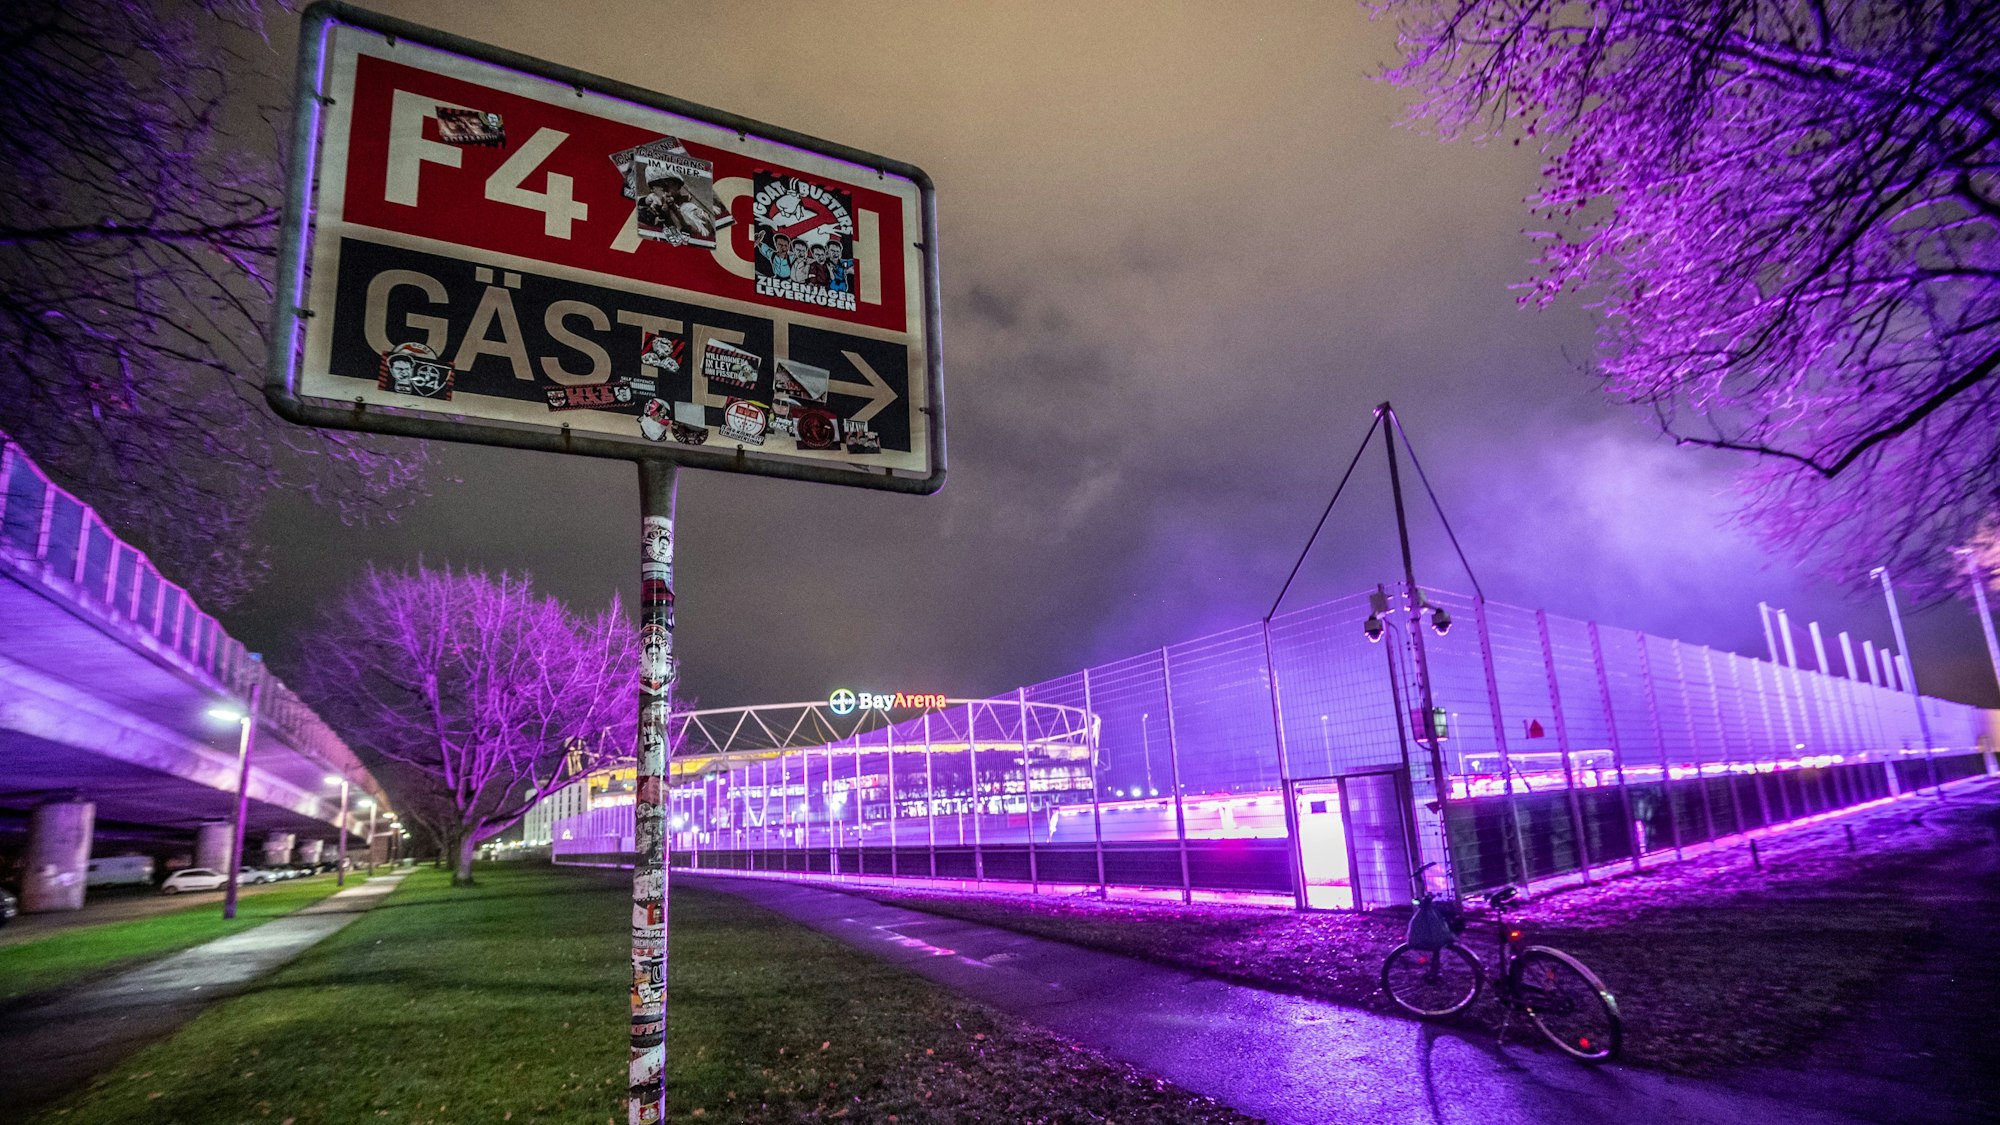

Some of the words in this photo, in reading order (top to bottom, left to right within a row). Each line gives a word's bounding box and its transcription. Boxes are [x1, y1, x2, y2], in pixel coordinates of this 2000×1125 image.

[648, 159, 661, 169] IM
[665, 163, 700, 177] VISIER
[753, 180, 785, 217] GOAT
[798, 181, 854, 235] BUSTERS
[756, 284, 857, 311] LEVERKUSEN
[363, 266, 746, 408] GÄSTE
[705, 352, 745, 365] WILLKOMMEN
[858, 692, 947, 712] BayArena
